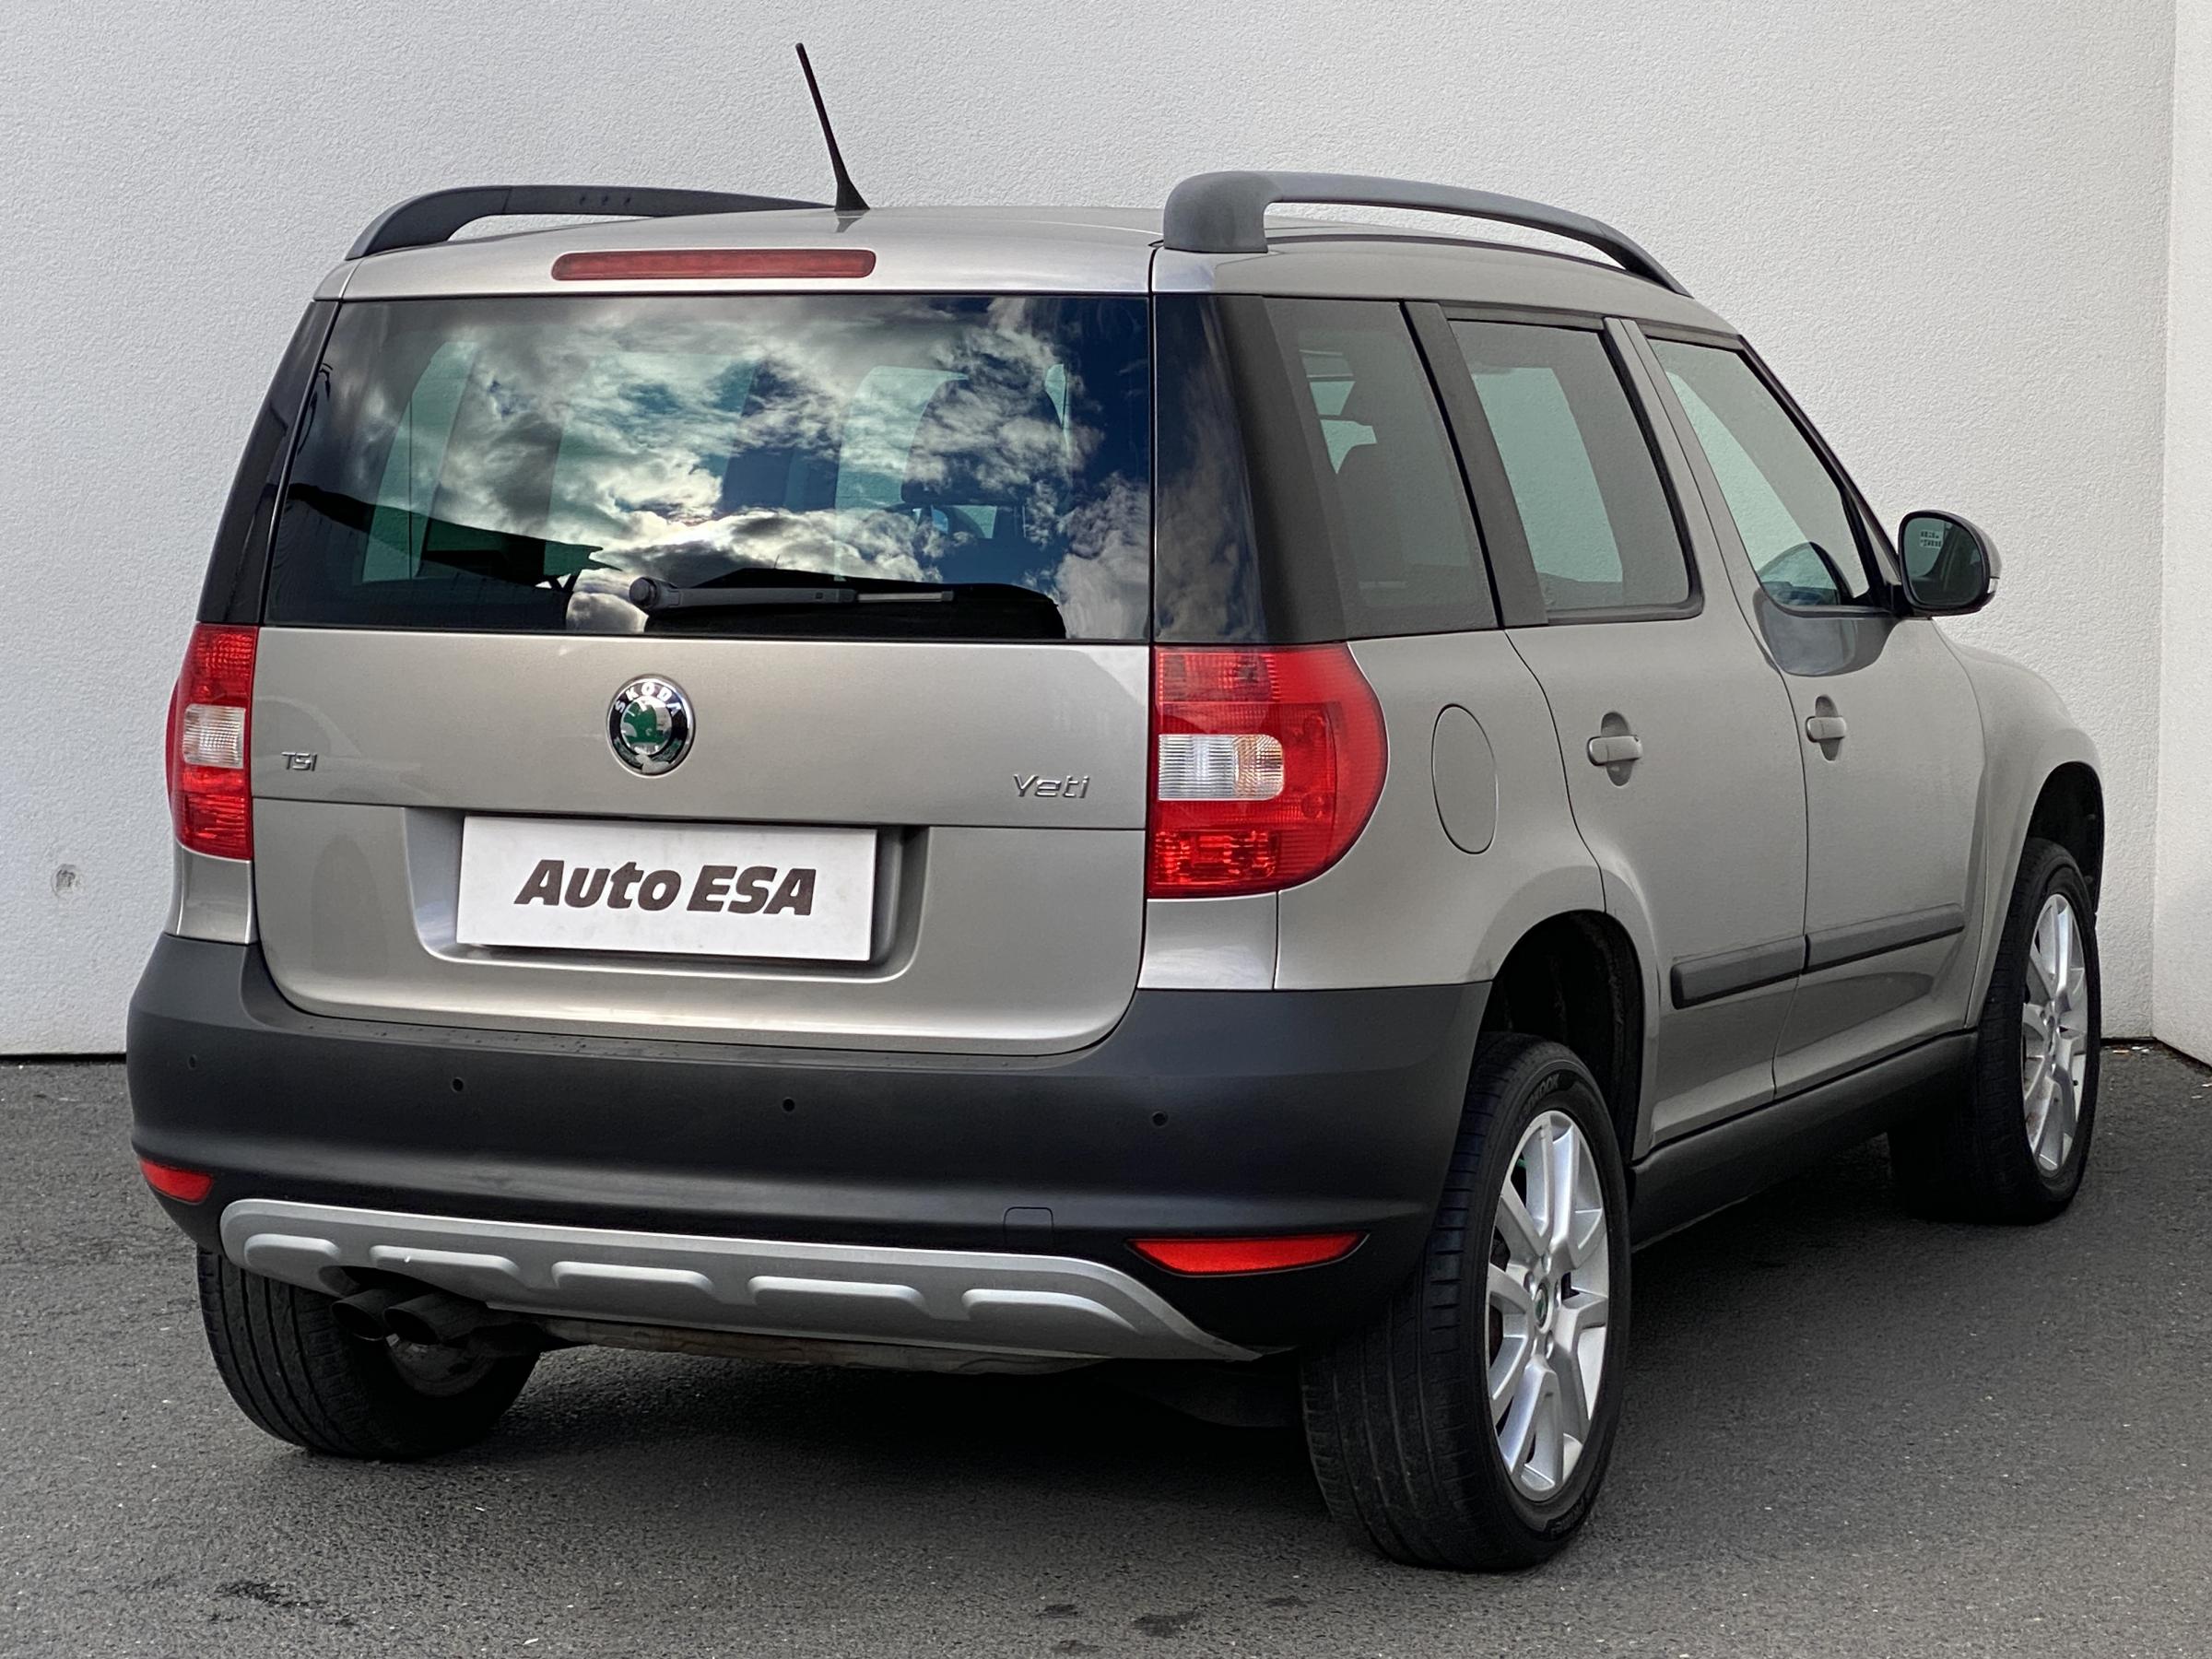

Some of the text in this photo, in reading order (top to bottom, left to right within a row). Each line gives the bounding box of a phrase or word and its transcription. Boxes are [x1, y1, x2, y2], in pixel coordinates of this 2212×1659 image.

[280, 751, 318, 771] TSI
[1013, 773, 1090, 799] Yeti
[513, 858, 818, 917] Auto ESA
